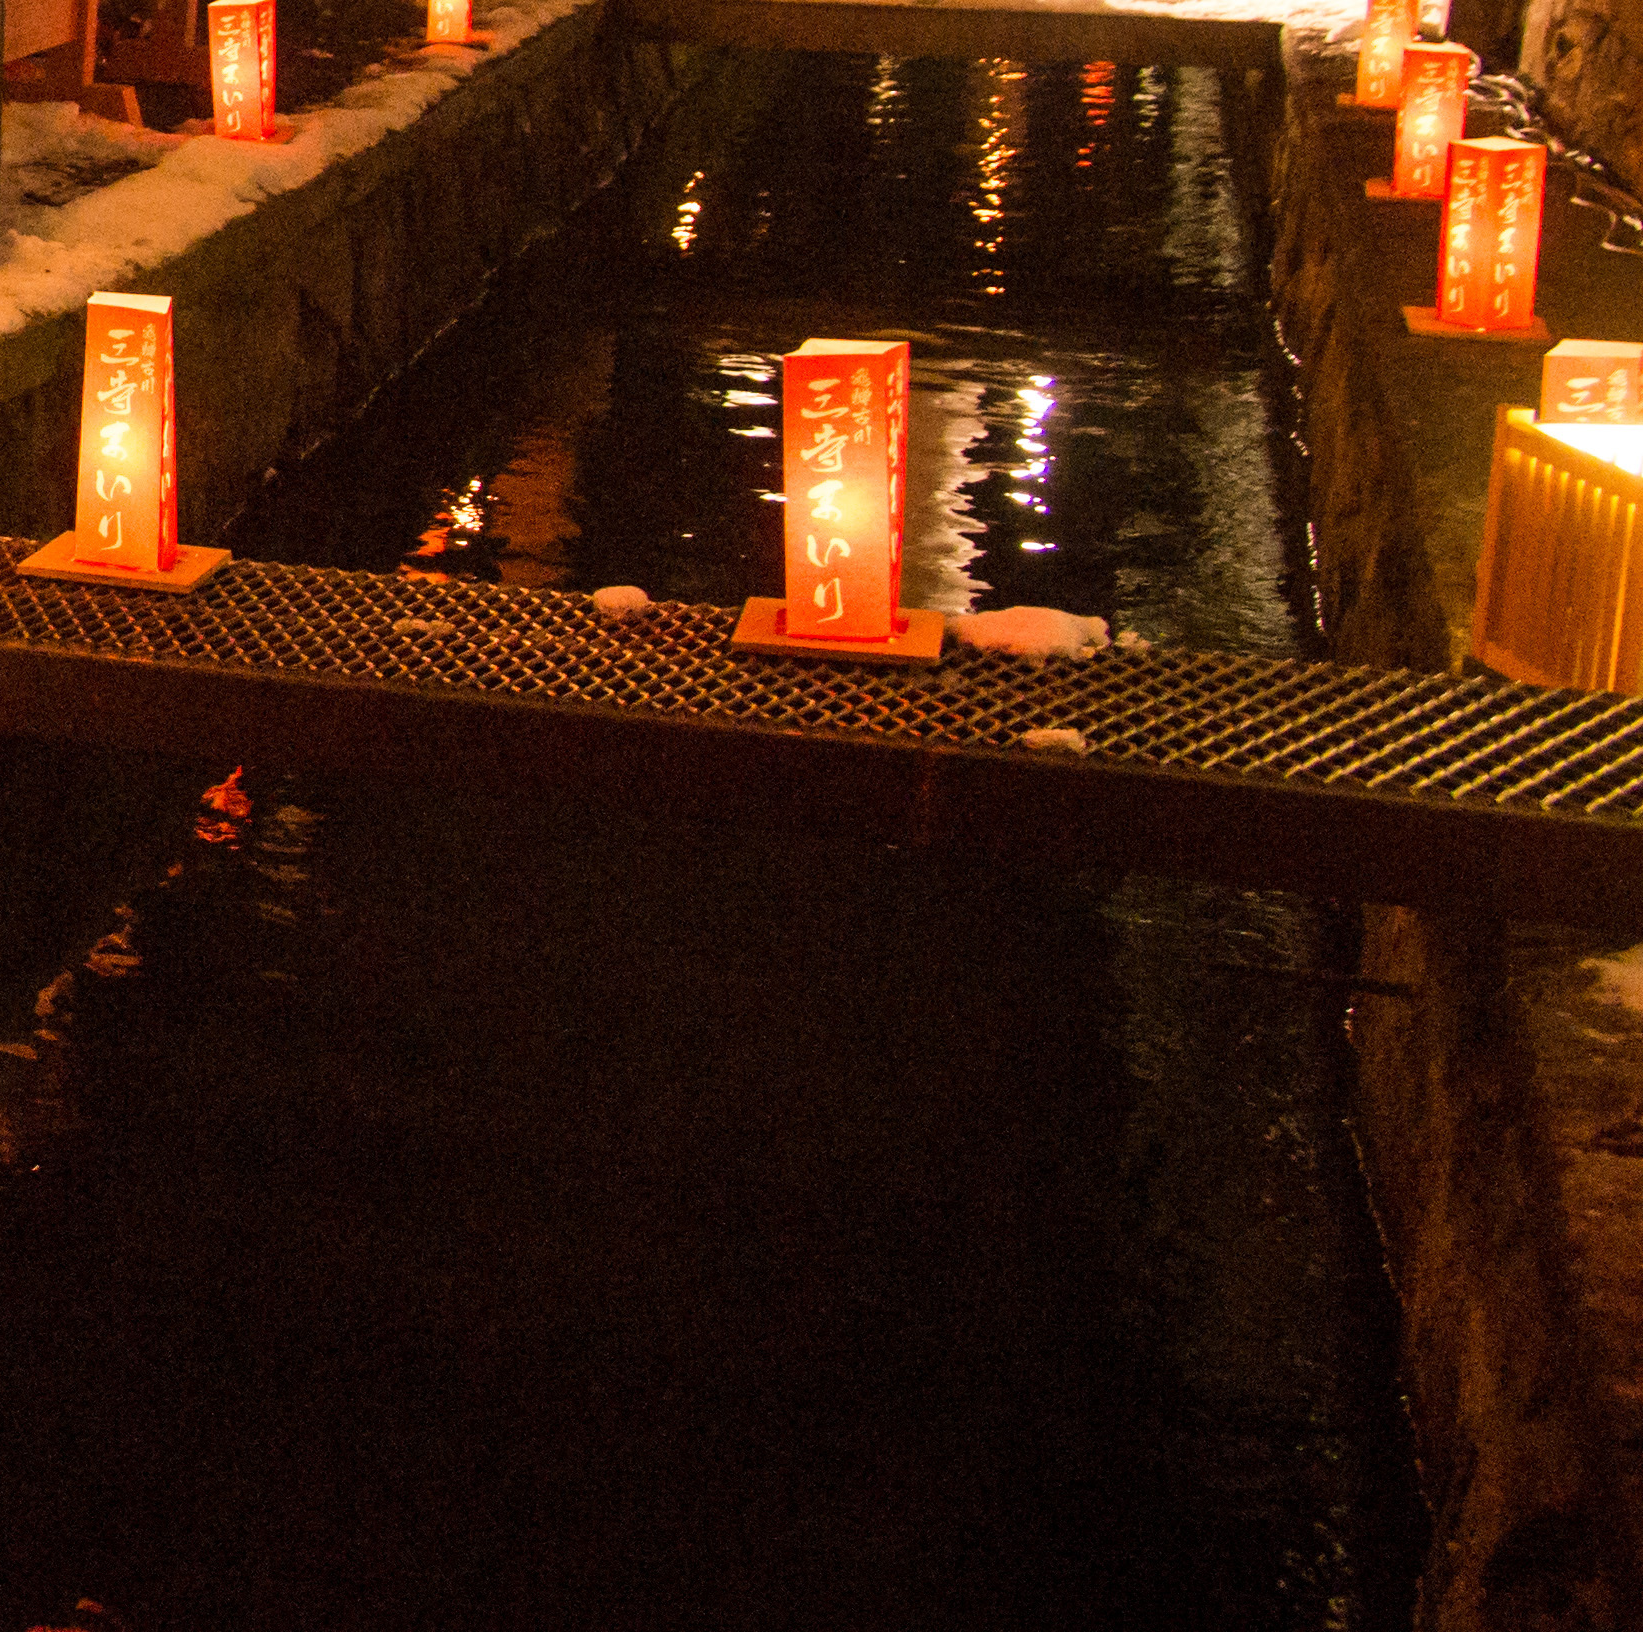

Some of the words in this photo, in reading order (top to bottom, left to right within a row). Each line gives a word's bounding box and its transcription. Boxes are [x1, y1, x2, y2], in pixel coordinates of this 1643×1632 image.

[218, 15, 243, 132] 三寺まいり
[1450, 159, 1477, 312] 三寺まいり
[96, 329, 140, 550] 三寺まいり
[800, 378, 851, 624] 三寺まいり
